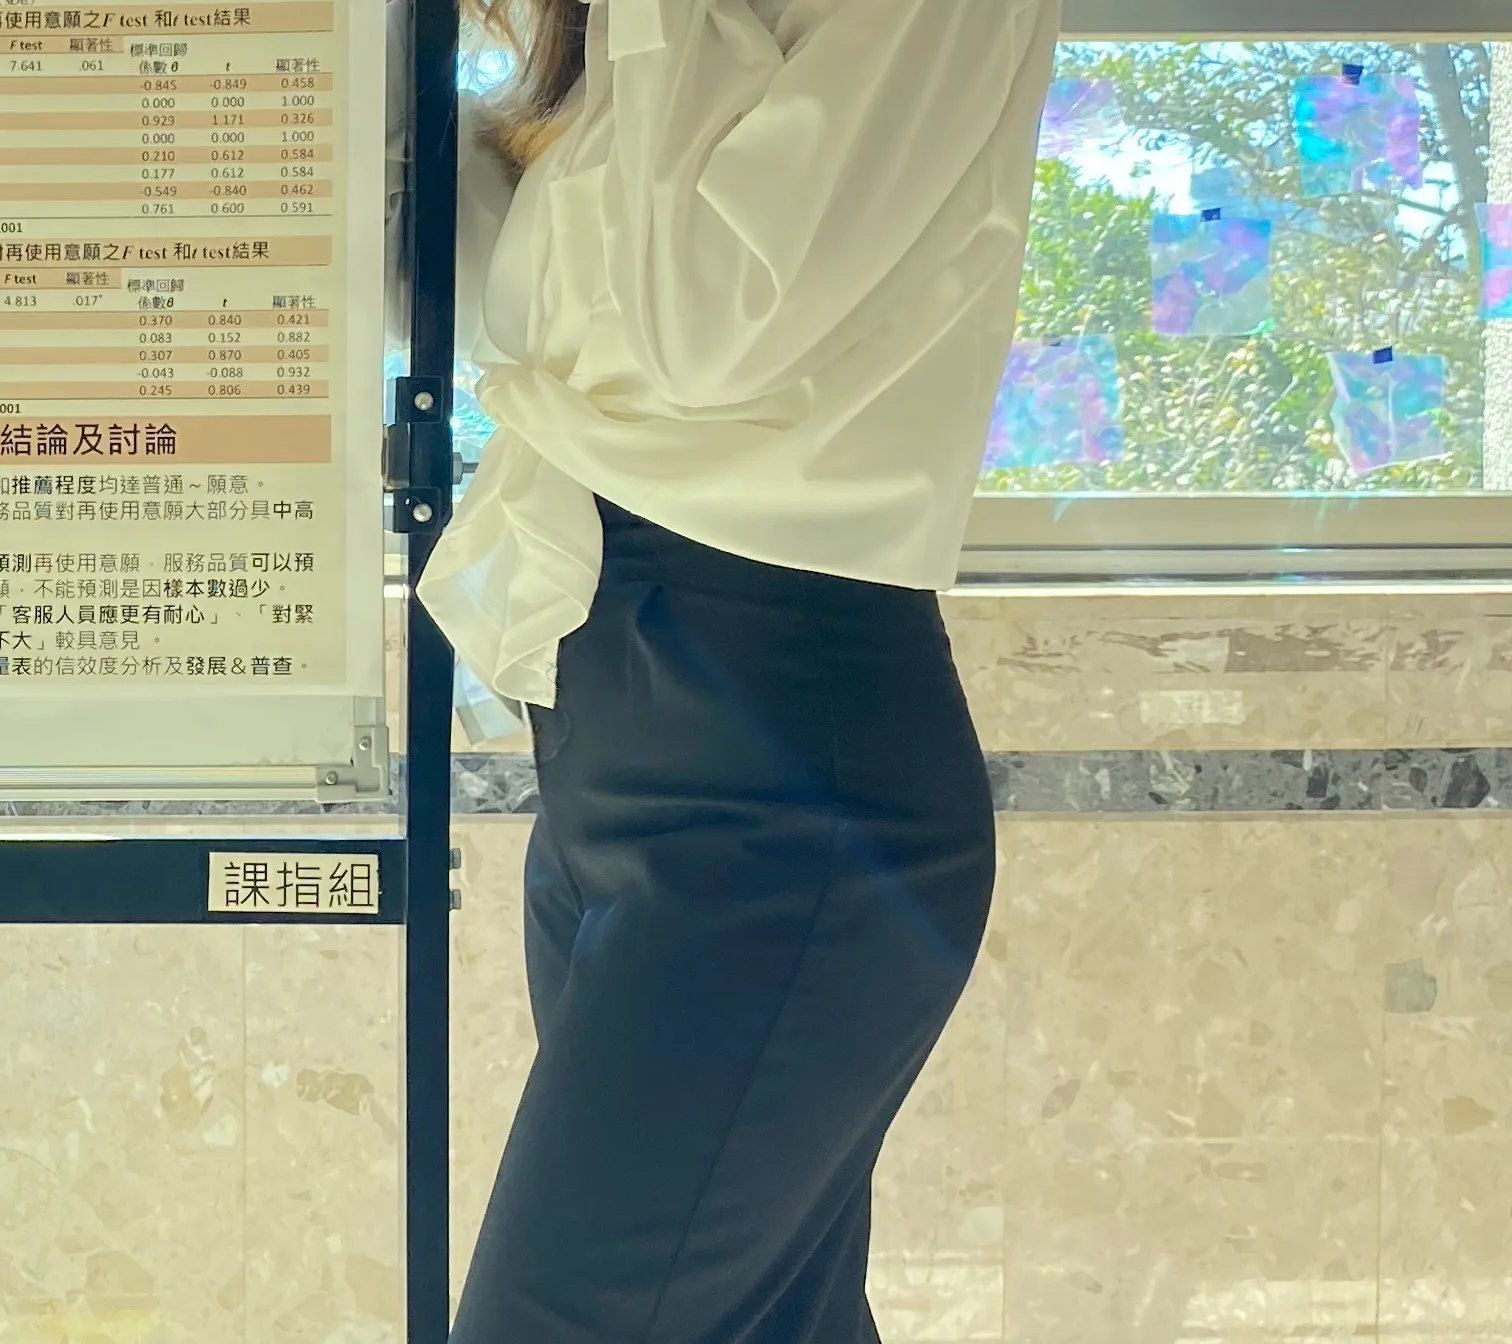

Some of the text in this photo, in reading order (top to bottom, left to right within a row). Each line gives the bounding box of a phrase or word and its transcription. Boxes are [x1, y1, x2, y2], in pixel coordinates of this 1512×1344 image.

[141, 96, 245, 109] 0.000 0.000
[0, 422, 177, 457] 結論及討論
[224, 862, 374, 908] 課指組
